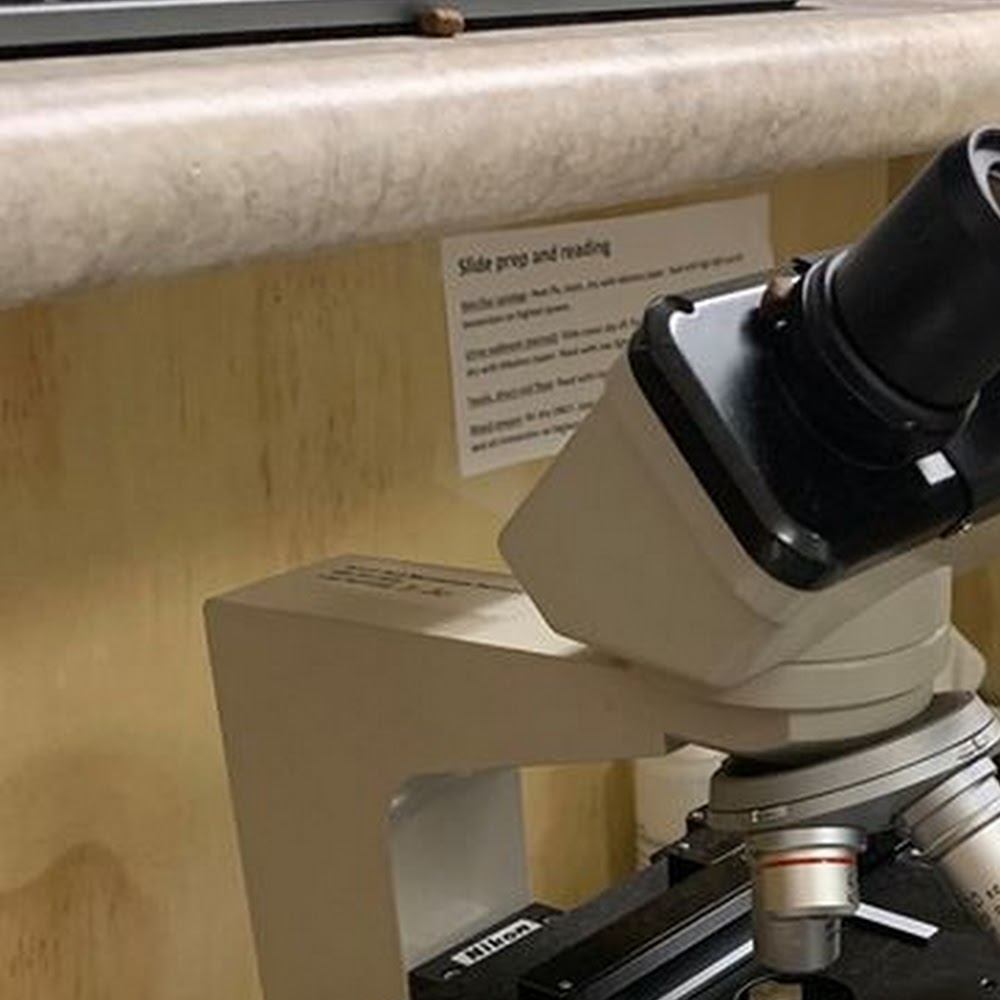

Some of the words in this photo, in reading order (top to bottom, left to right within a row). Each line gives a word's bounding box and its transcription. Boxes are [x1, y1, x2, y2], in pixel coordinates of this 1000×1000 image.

[458, 255, 492, 276] Slide
[496, 252, 528, 273] prep
[532, 244, 558, 264] and
[560, 239, 611, 260] reading
[464, 922, 531, 961] Nikon
